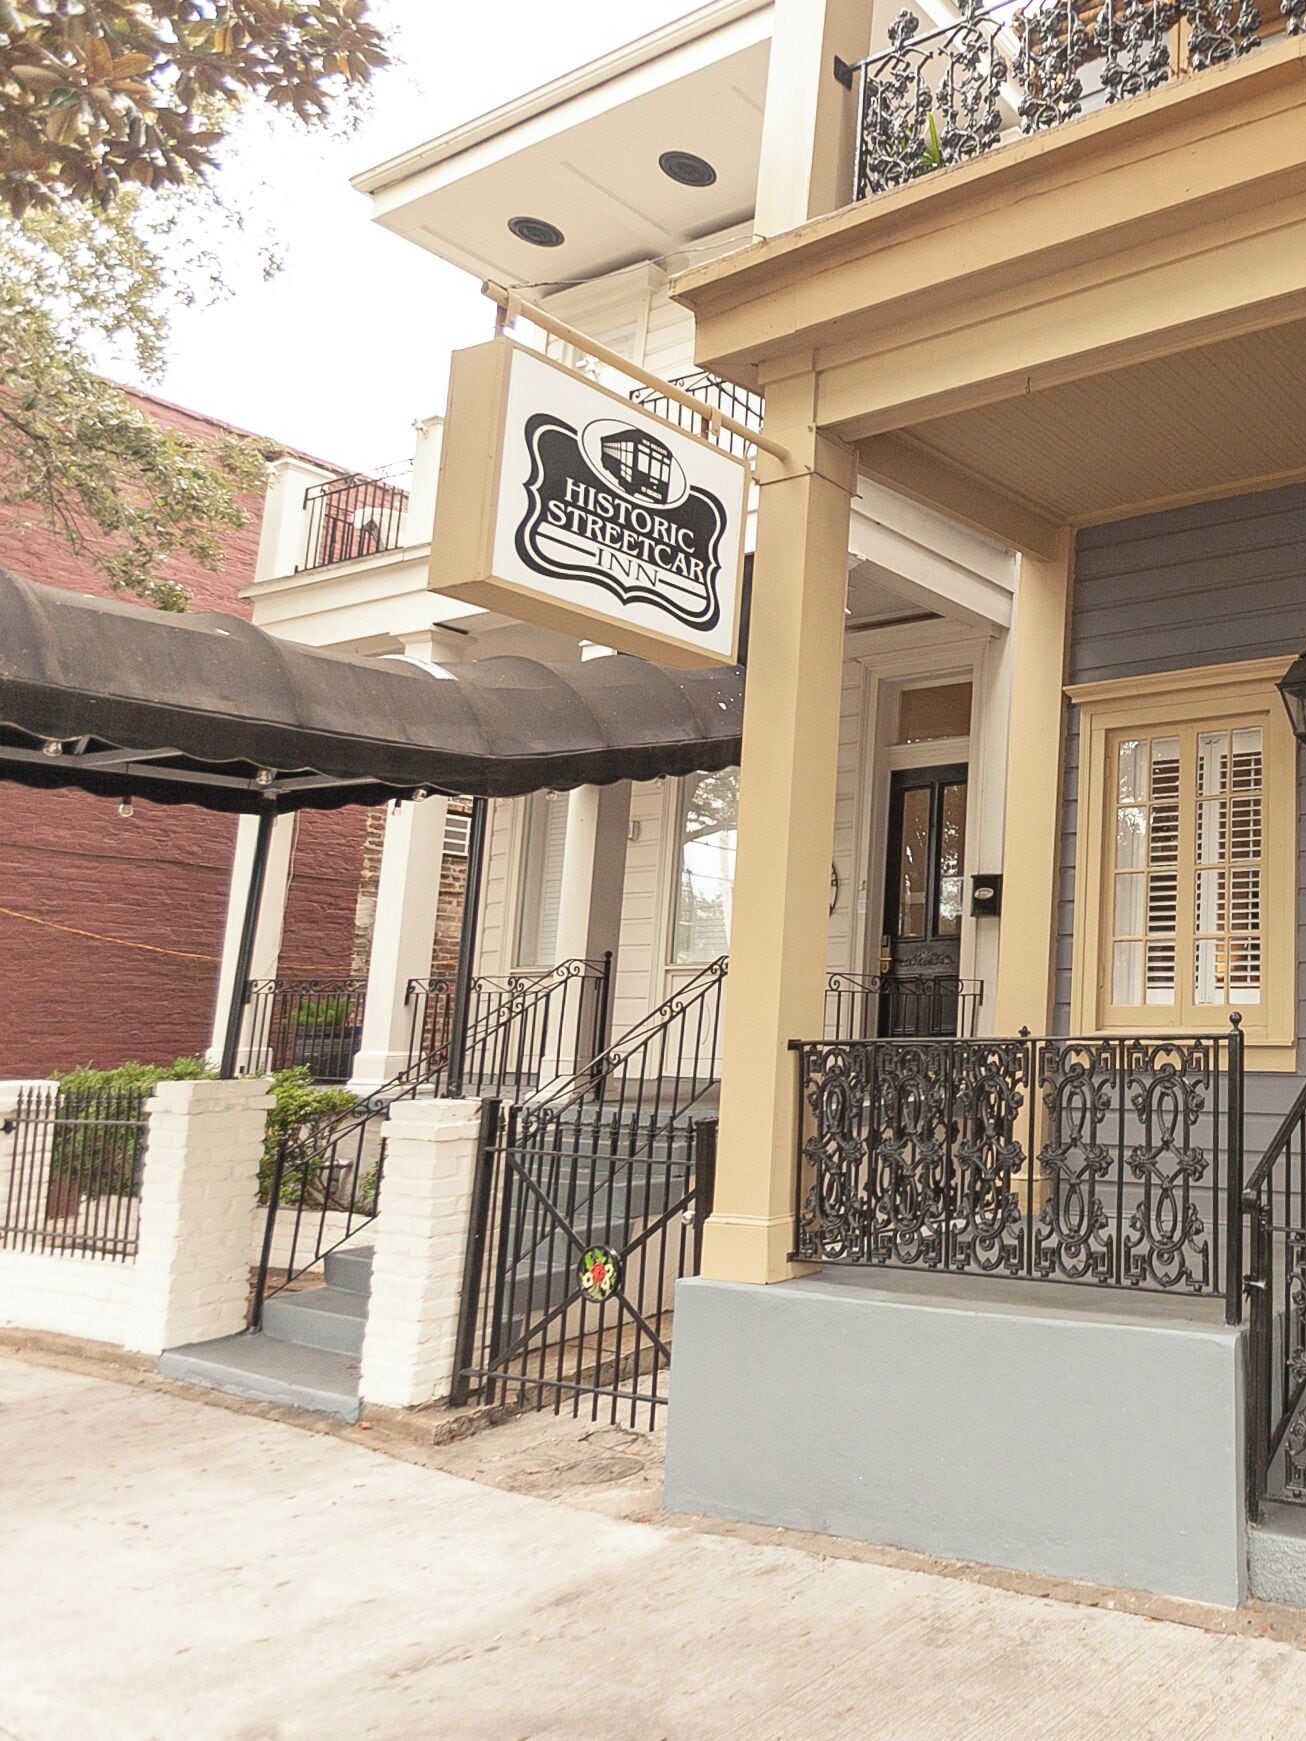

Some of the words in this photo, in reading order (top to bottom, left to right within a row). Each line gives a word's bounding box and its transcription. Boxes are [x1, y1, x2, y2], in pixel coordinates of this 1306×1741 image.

[547, 500, 705, 583] STREETCAR
[565, 477, 696, 553] HISTORIC
[597, 547, 660, 587] INN
